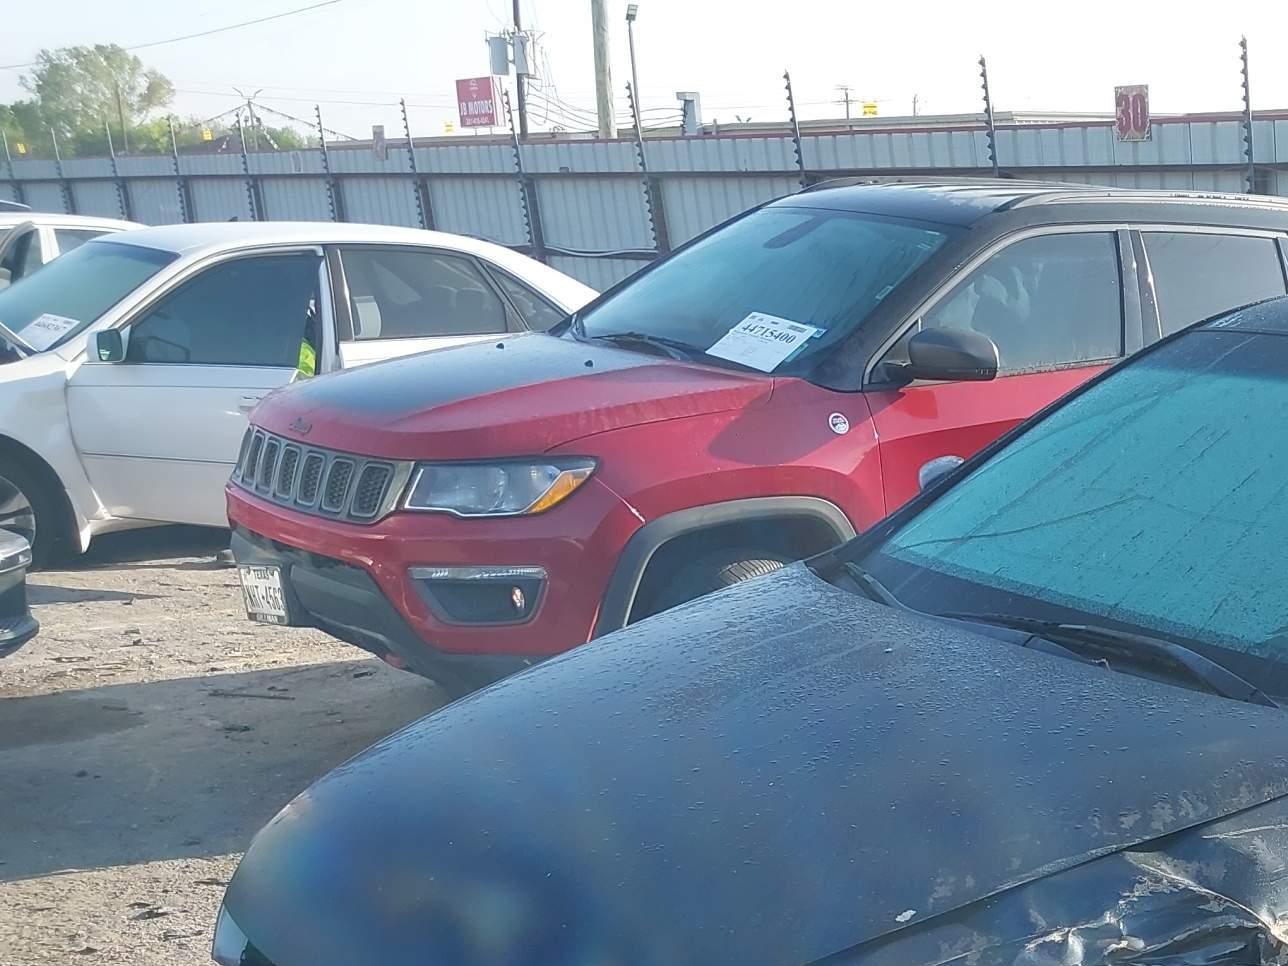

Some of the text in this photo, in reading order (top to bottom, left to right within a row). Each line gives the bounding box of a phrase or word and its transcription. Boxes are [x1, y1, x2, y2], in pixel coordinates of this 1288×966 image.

[468, 100, 493, 115] MOTORS
[1117, 94, 1147, 137] 30
[742, 324, 797, 344] 44715400
